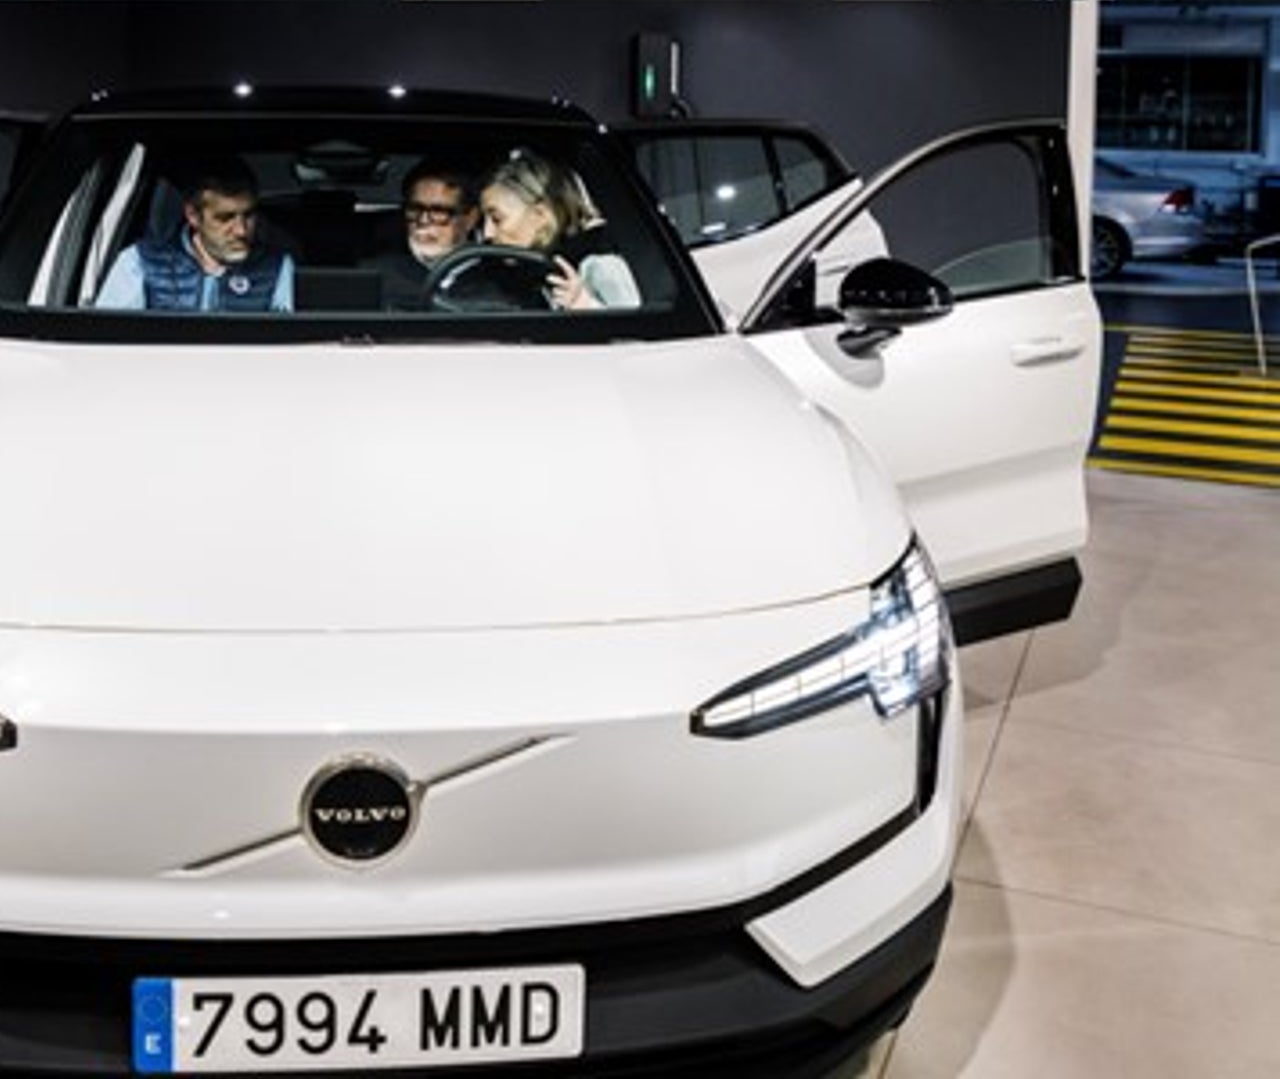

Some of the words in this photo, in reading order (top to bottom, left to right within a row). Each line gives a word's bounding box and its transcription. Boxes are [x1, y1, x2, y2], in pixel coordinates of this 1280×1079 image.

[314, 806, 407, 823] VOLVO
[144, 1033, 162, 1054] E
[192, 989, 387, 1058] 7994
[419, 981, 561, 1052] MMD
